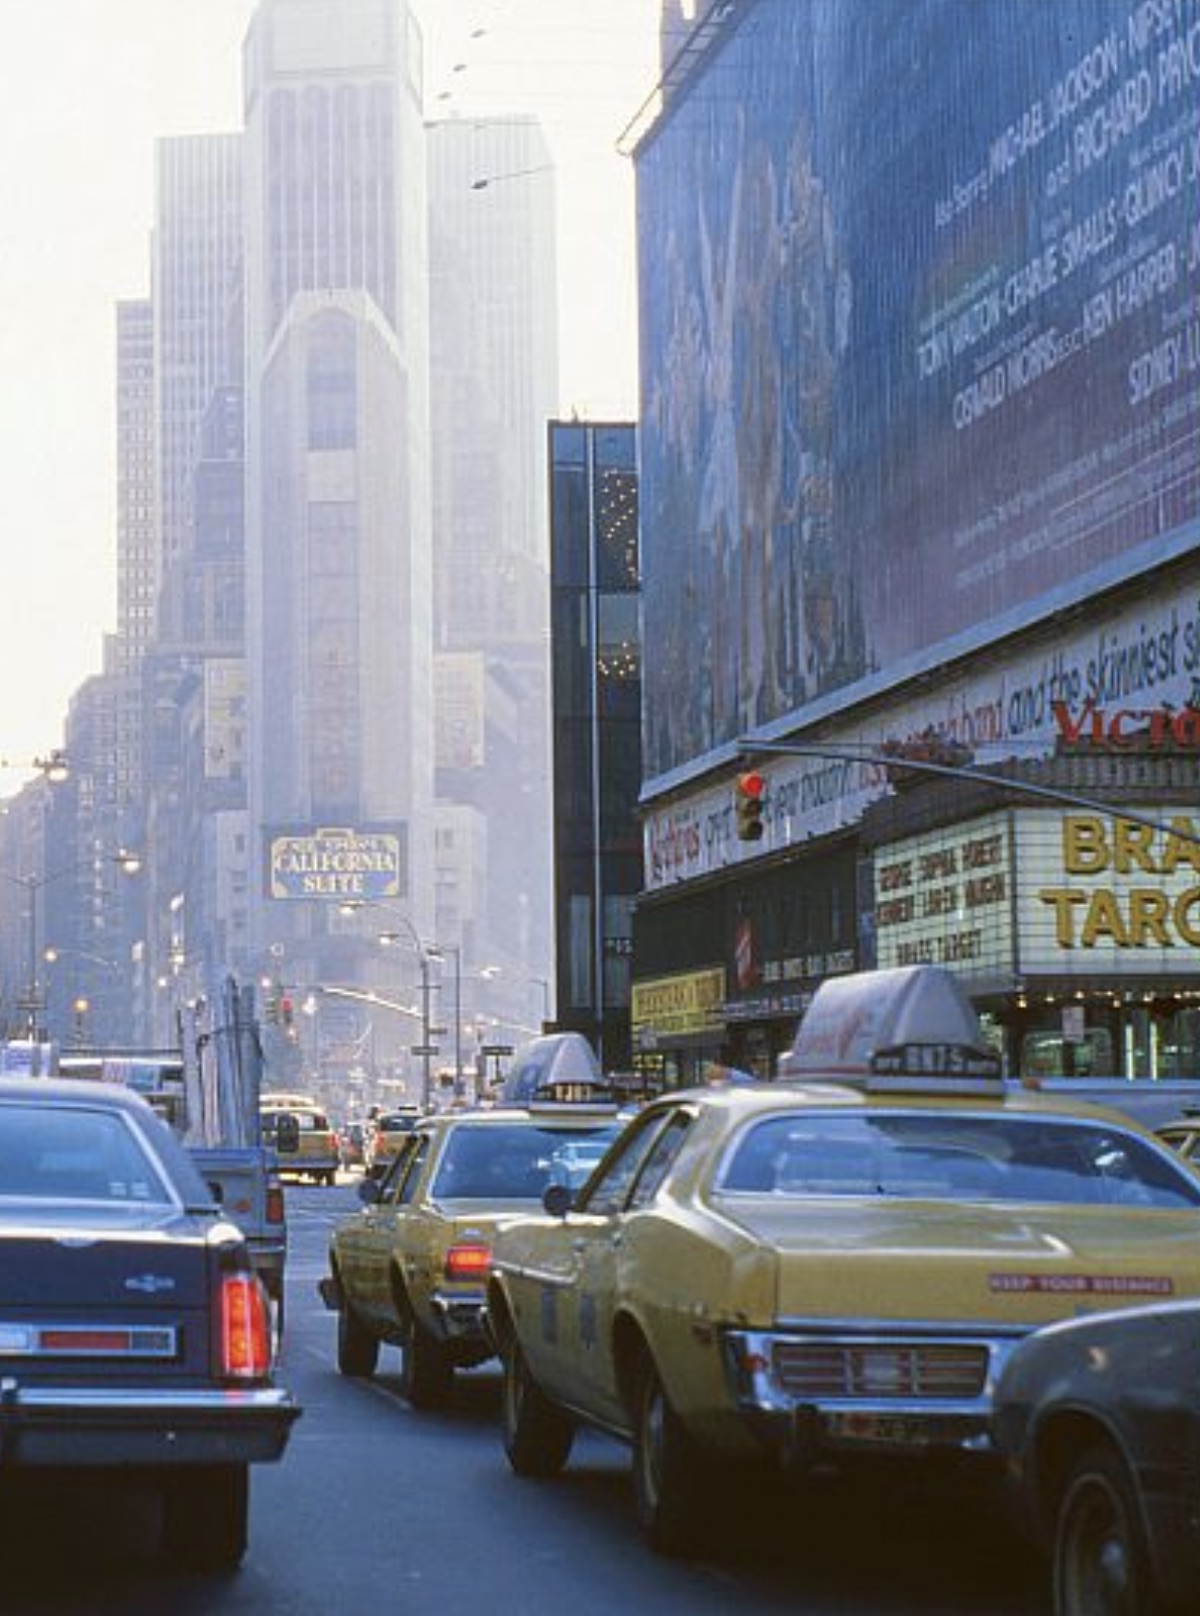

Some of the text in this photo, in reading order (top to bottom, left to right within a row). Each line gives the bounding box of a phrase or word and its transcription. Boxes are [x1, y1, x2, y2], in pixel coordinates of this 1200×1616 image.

[990, 100, 1046, 184] MICHAEL
[1046, 38, 1118, 132] JACKSON
[1074, 68, 1151, 175] RICHARD
[1061, 198, 1117, 279] SMALLS
[1124, 143, 1185, 227] QUINCY
[1115, 242, 1176, 321] HARPER
[1128, 328, 1184, 406] SIDNEY
[1009, 665, 1048, 736] and
[1086, 607, 1179, 702] skinniest
[274, 850, 396, 872] CALIFORNIA
[303, 872, 364, 894] SUITE
[990, 1275, 1029, 1292] KEEP
[1040, 1276, 1088, 1293] YOUR
